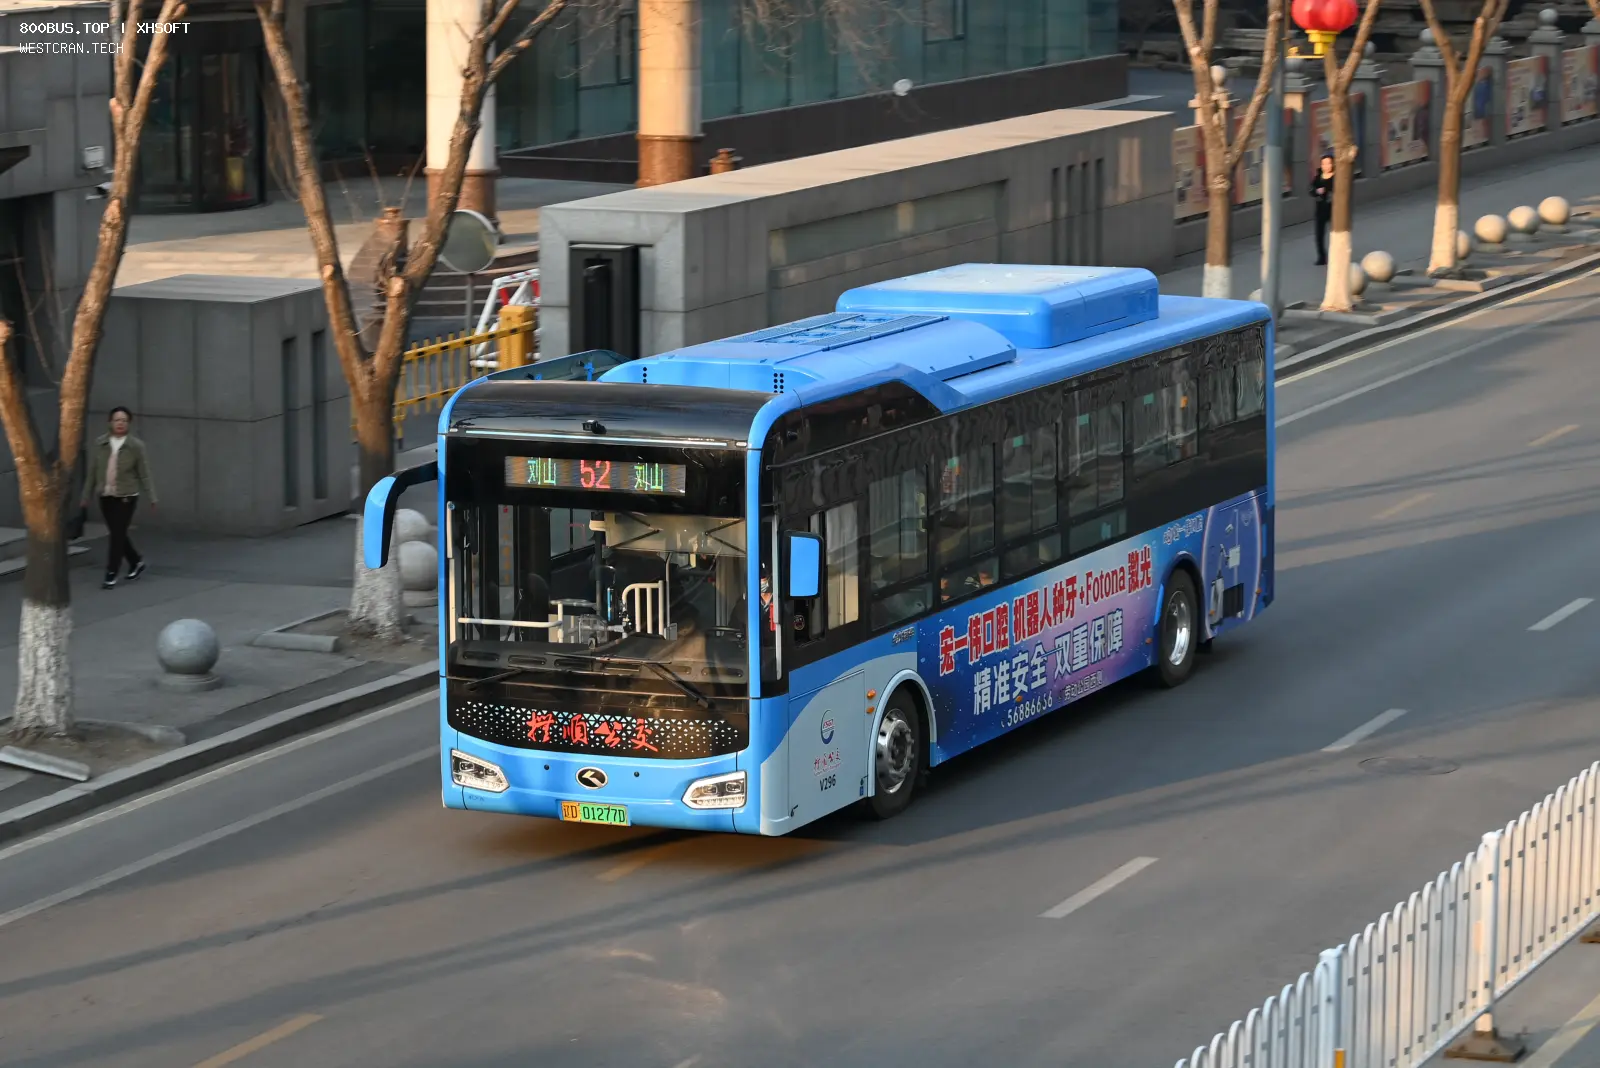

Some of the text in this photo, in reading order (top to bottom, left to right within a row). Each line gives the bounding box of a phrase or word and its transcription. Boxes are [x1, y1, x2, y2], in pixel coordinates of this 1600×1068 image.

[527, 457, 664, 492] 刘山 52 刘山
[973, 608, 1124, 716] 精准安全 双重保障
[1006, 691, 1053, 728] 56886656
[820, 774, 837, 792] V296
